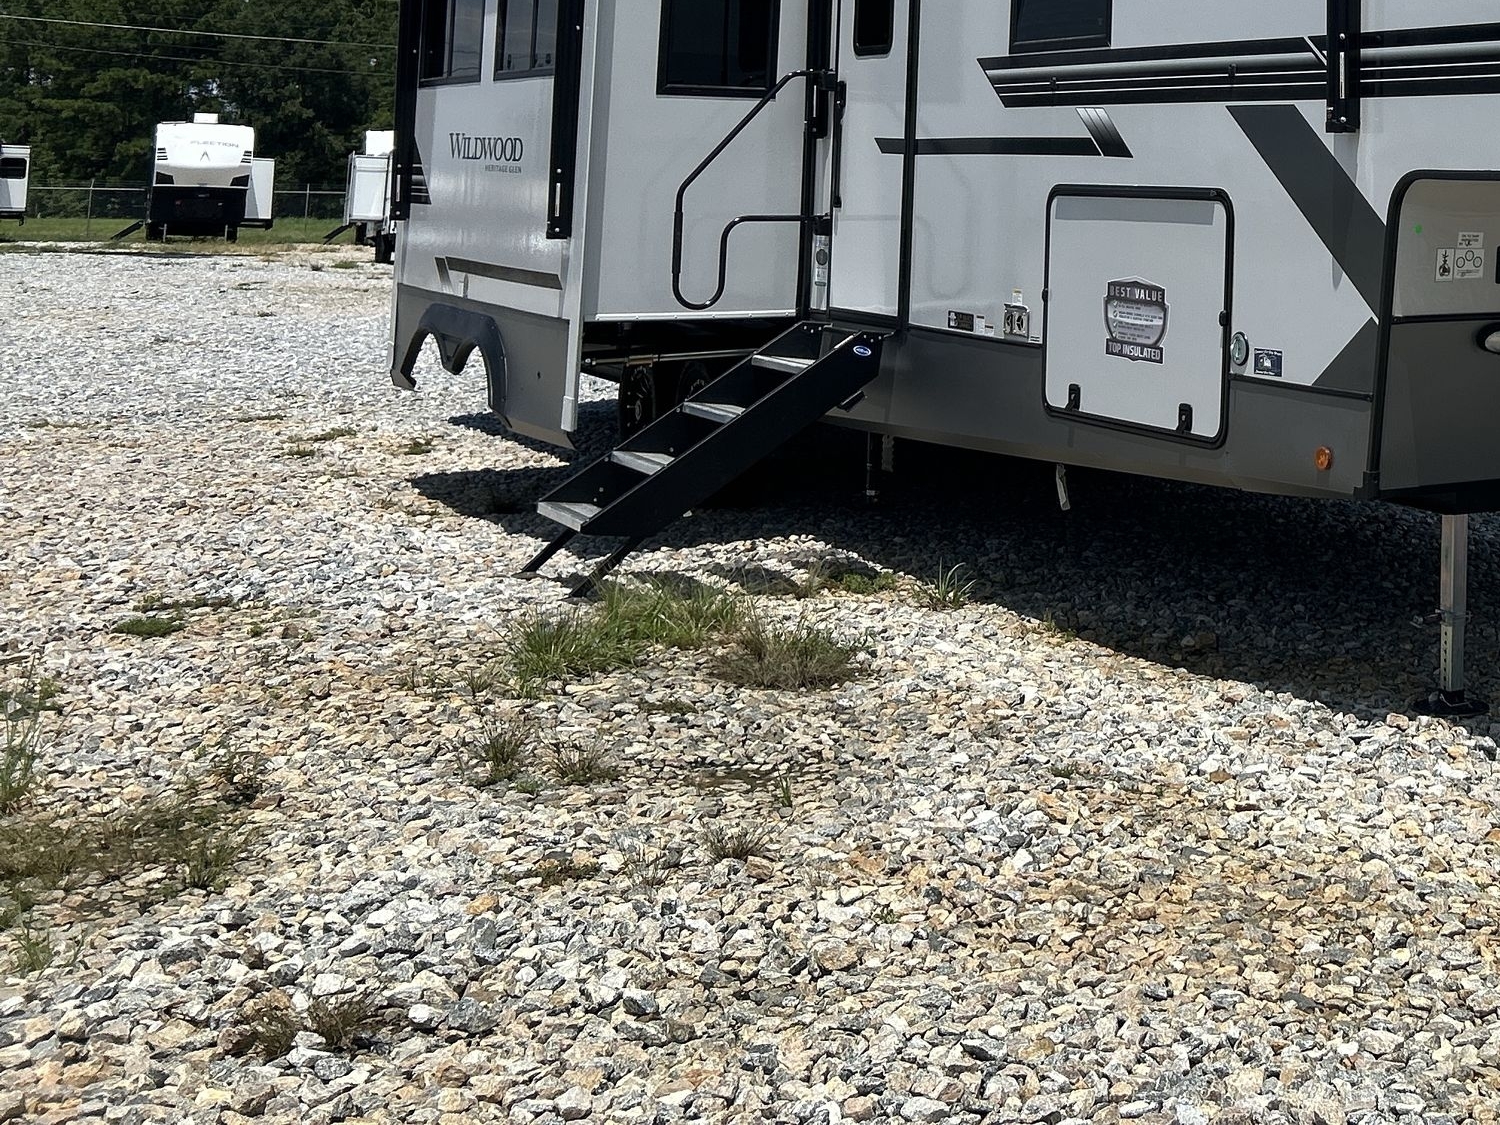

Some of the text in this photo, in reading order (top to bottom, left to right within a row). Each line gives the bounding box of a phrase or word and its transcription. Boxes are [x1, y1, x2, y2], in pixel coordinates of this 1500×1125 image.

[449, 133, 523, 162] WILDWOOD
[508, 165, 522, 174] GLEN
[1109, 285, 1163, 302] BEST VALUE
[1108, 341, 1161, 360] TOP INSULATED
